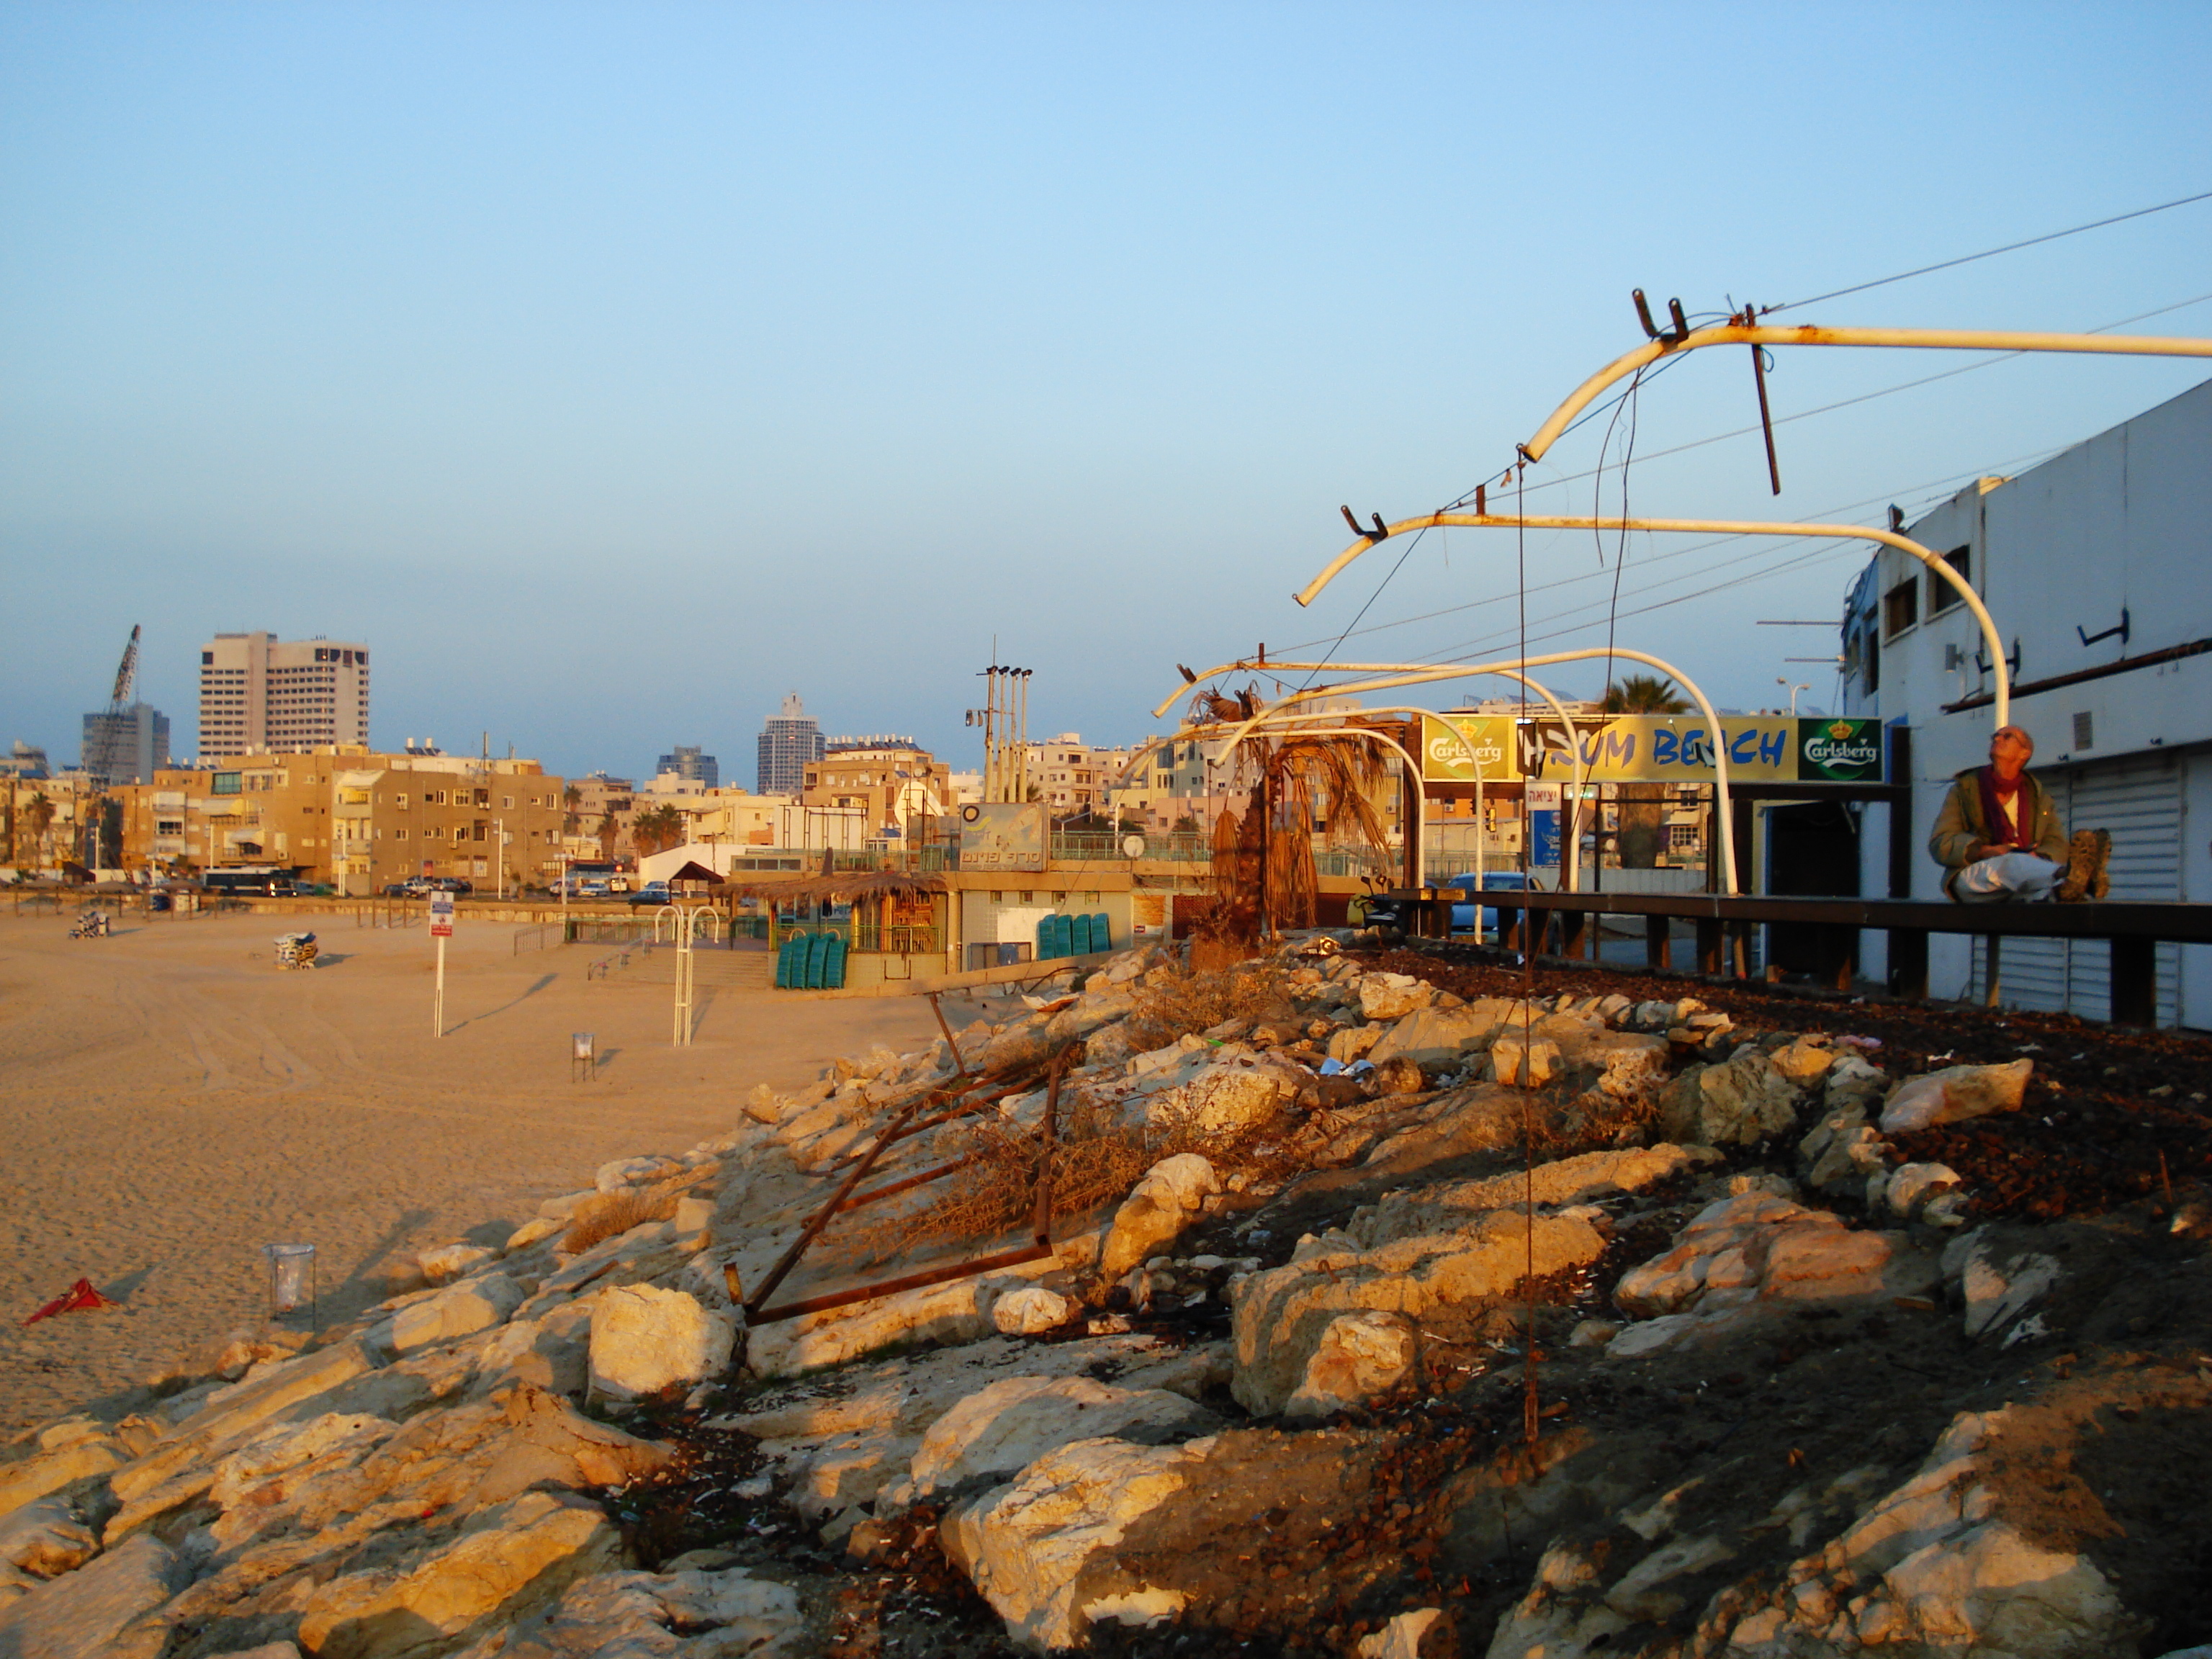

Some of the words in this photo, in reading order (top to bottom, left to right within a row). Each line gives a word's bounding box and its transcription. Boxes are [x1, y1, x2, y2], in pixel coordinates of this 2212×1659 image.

[1429, 738, 1503, 765] Carlserg
[1804, 737, 1878, 765] Carlsberg
[1528, 790, 1557, 802] יציאה
[1007, 852, 1041, 864] סרף
